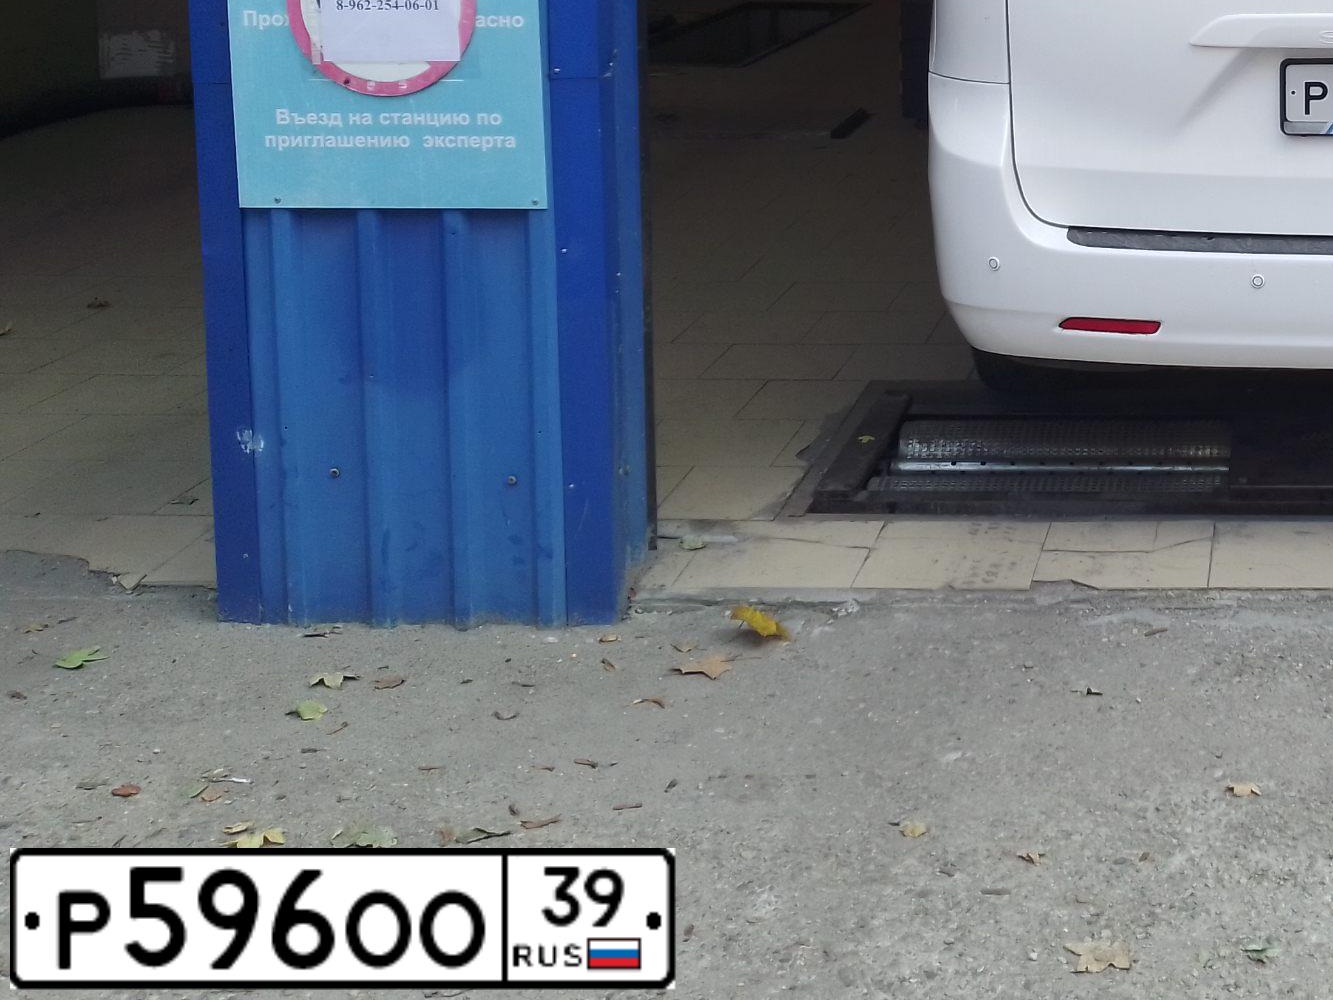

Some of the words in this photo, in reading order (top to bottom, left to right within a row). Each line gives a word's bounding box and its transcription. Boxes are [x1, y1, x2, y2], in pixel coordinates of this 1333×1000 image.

[336, 0, 440, 11] 8-962-254-06-01
[275, 109, 342, 126] Въезд
[349, 113, 373, 125] на
[379, 112, 470, 127] станцию
[476, 112, 502, 125] по
[265, 135, 411, 150] приглашению
[422, 135, 516, 151] эксперта
